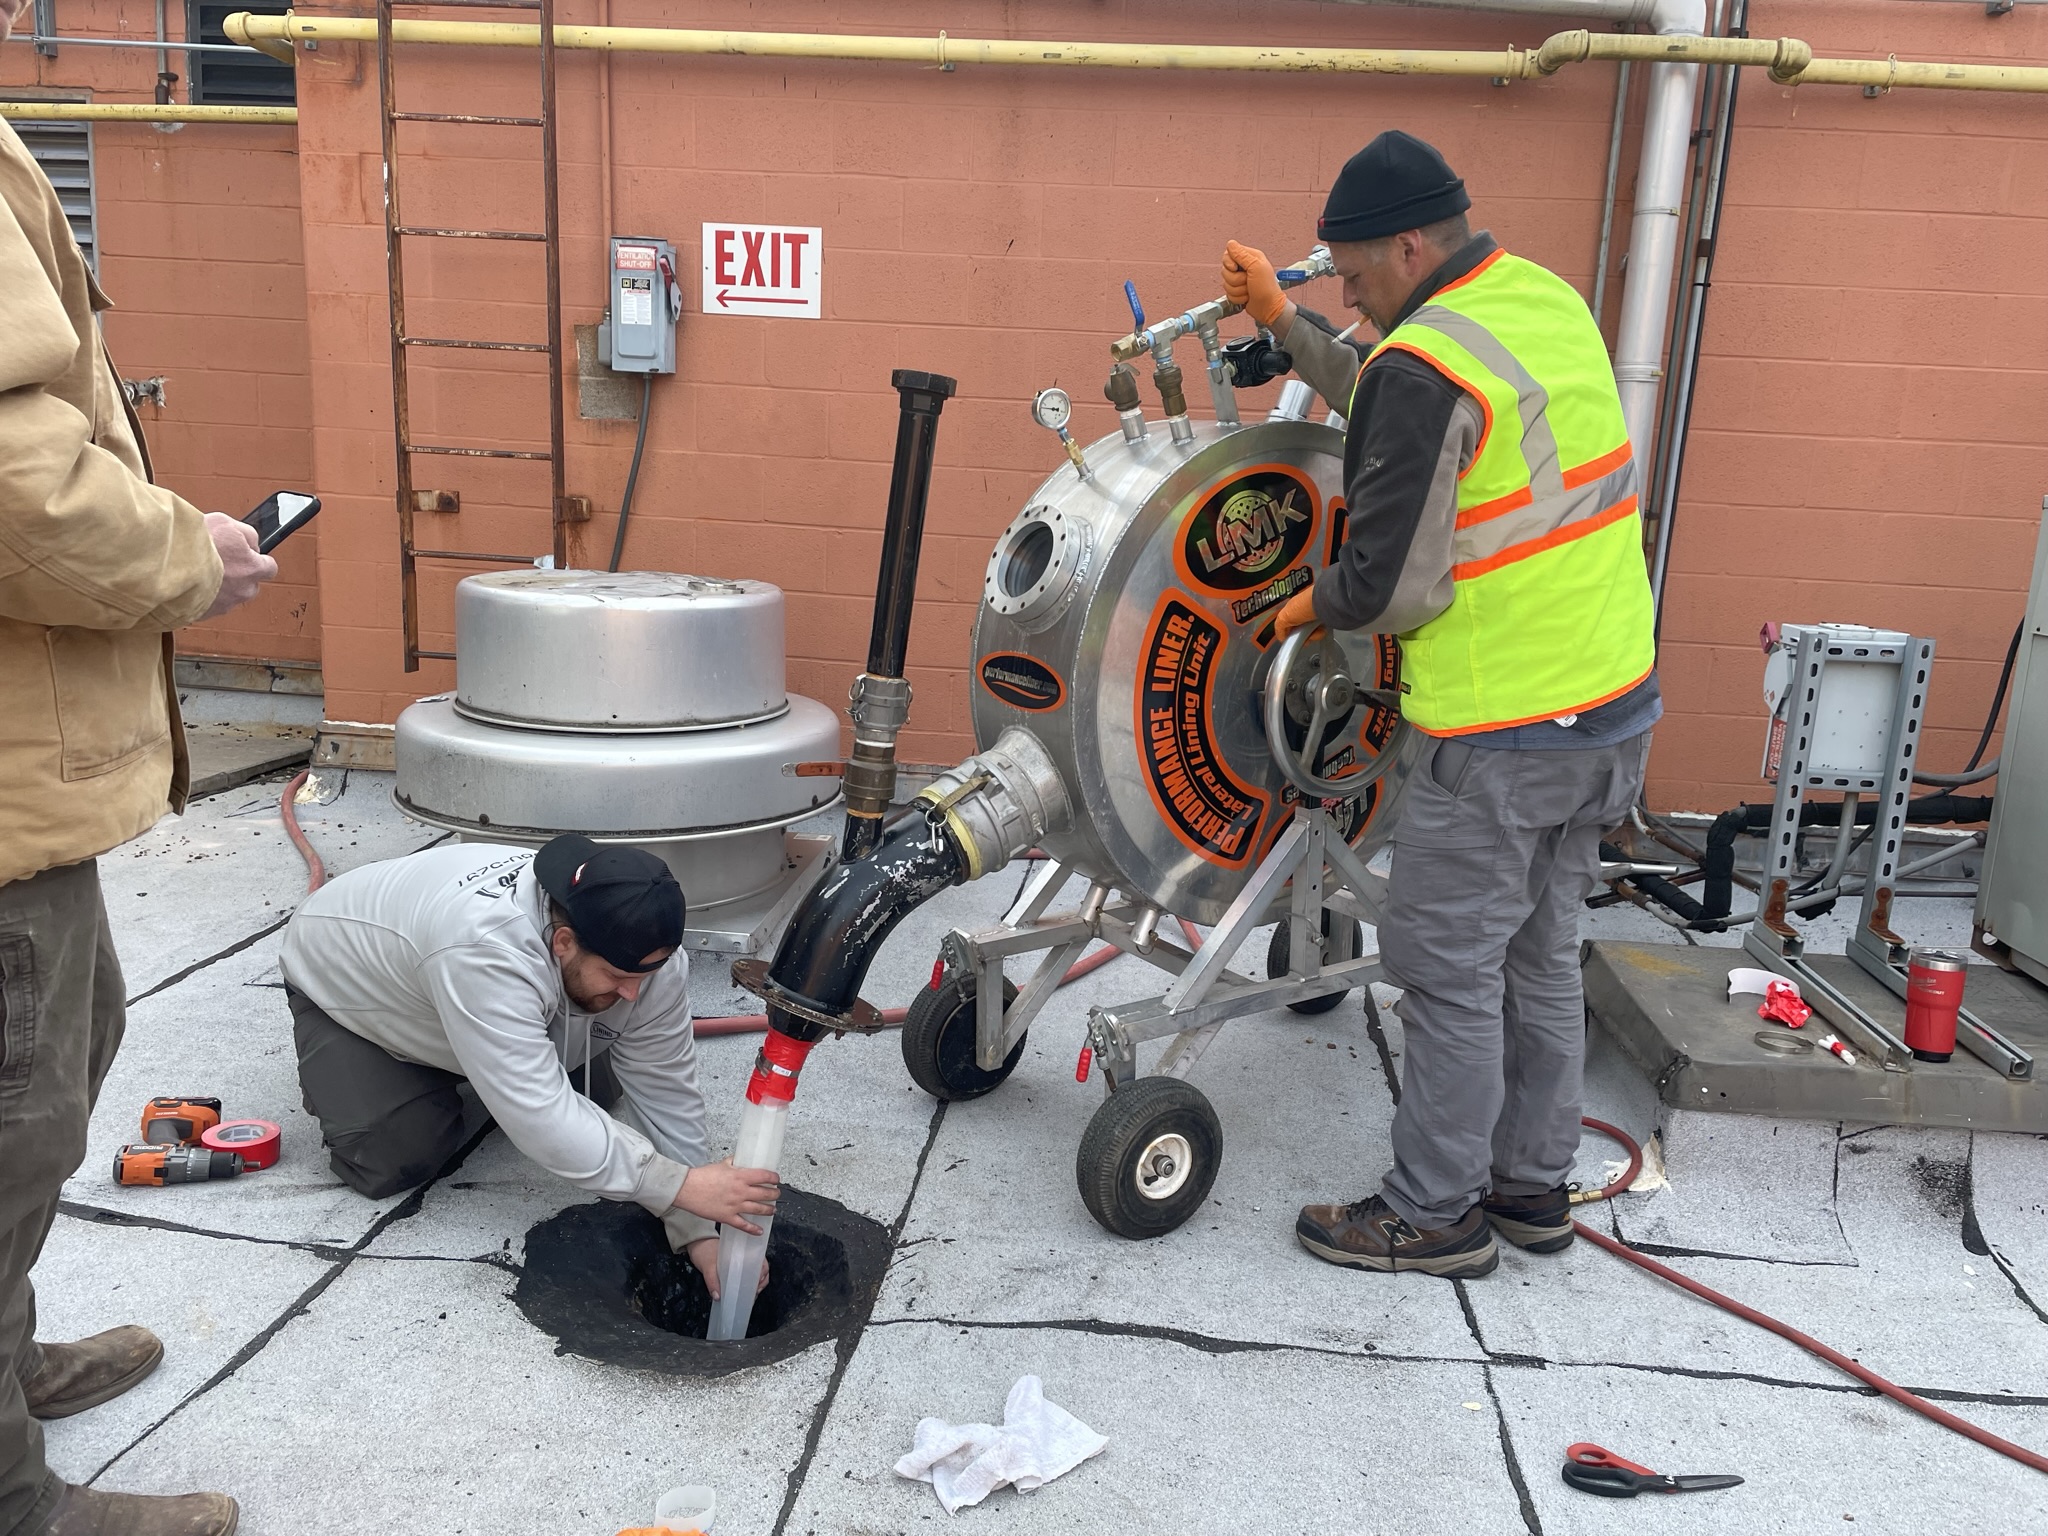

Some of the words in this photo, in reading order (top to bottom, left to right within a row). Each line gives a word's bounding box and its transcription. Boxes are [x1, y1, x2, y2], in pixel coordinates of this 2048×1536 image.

[619, 260, 652, 268] SHUT-OFF
[715, 230, 809, 288] EXIT
[1196, 488, 1309, 573] LMK
[1232, 566, 1309, 620] Technologies
[1184, 632, 1211, 687] Unit
[1182, 691, 1206, 766] Lining
[1150, 706, 1246, 855] PERFORMANCE
[1195, 765, 1254, 820] Lateral
